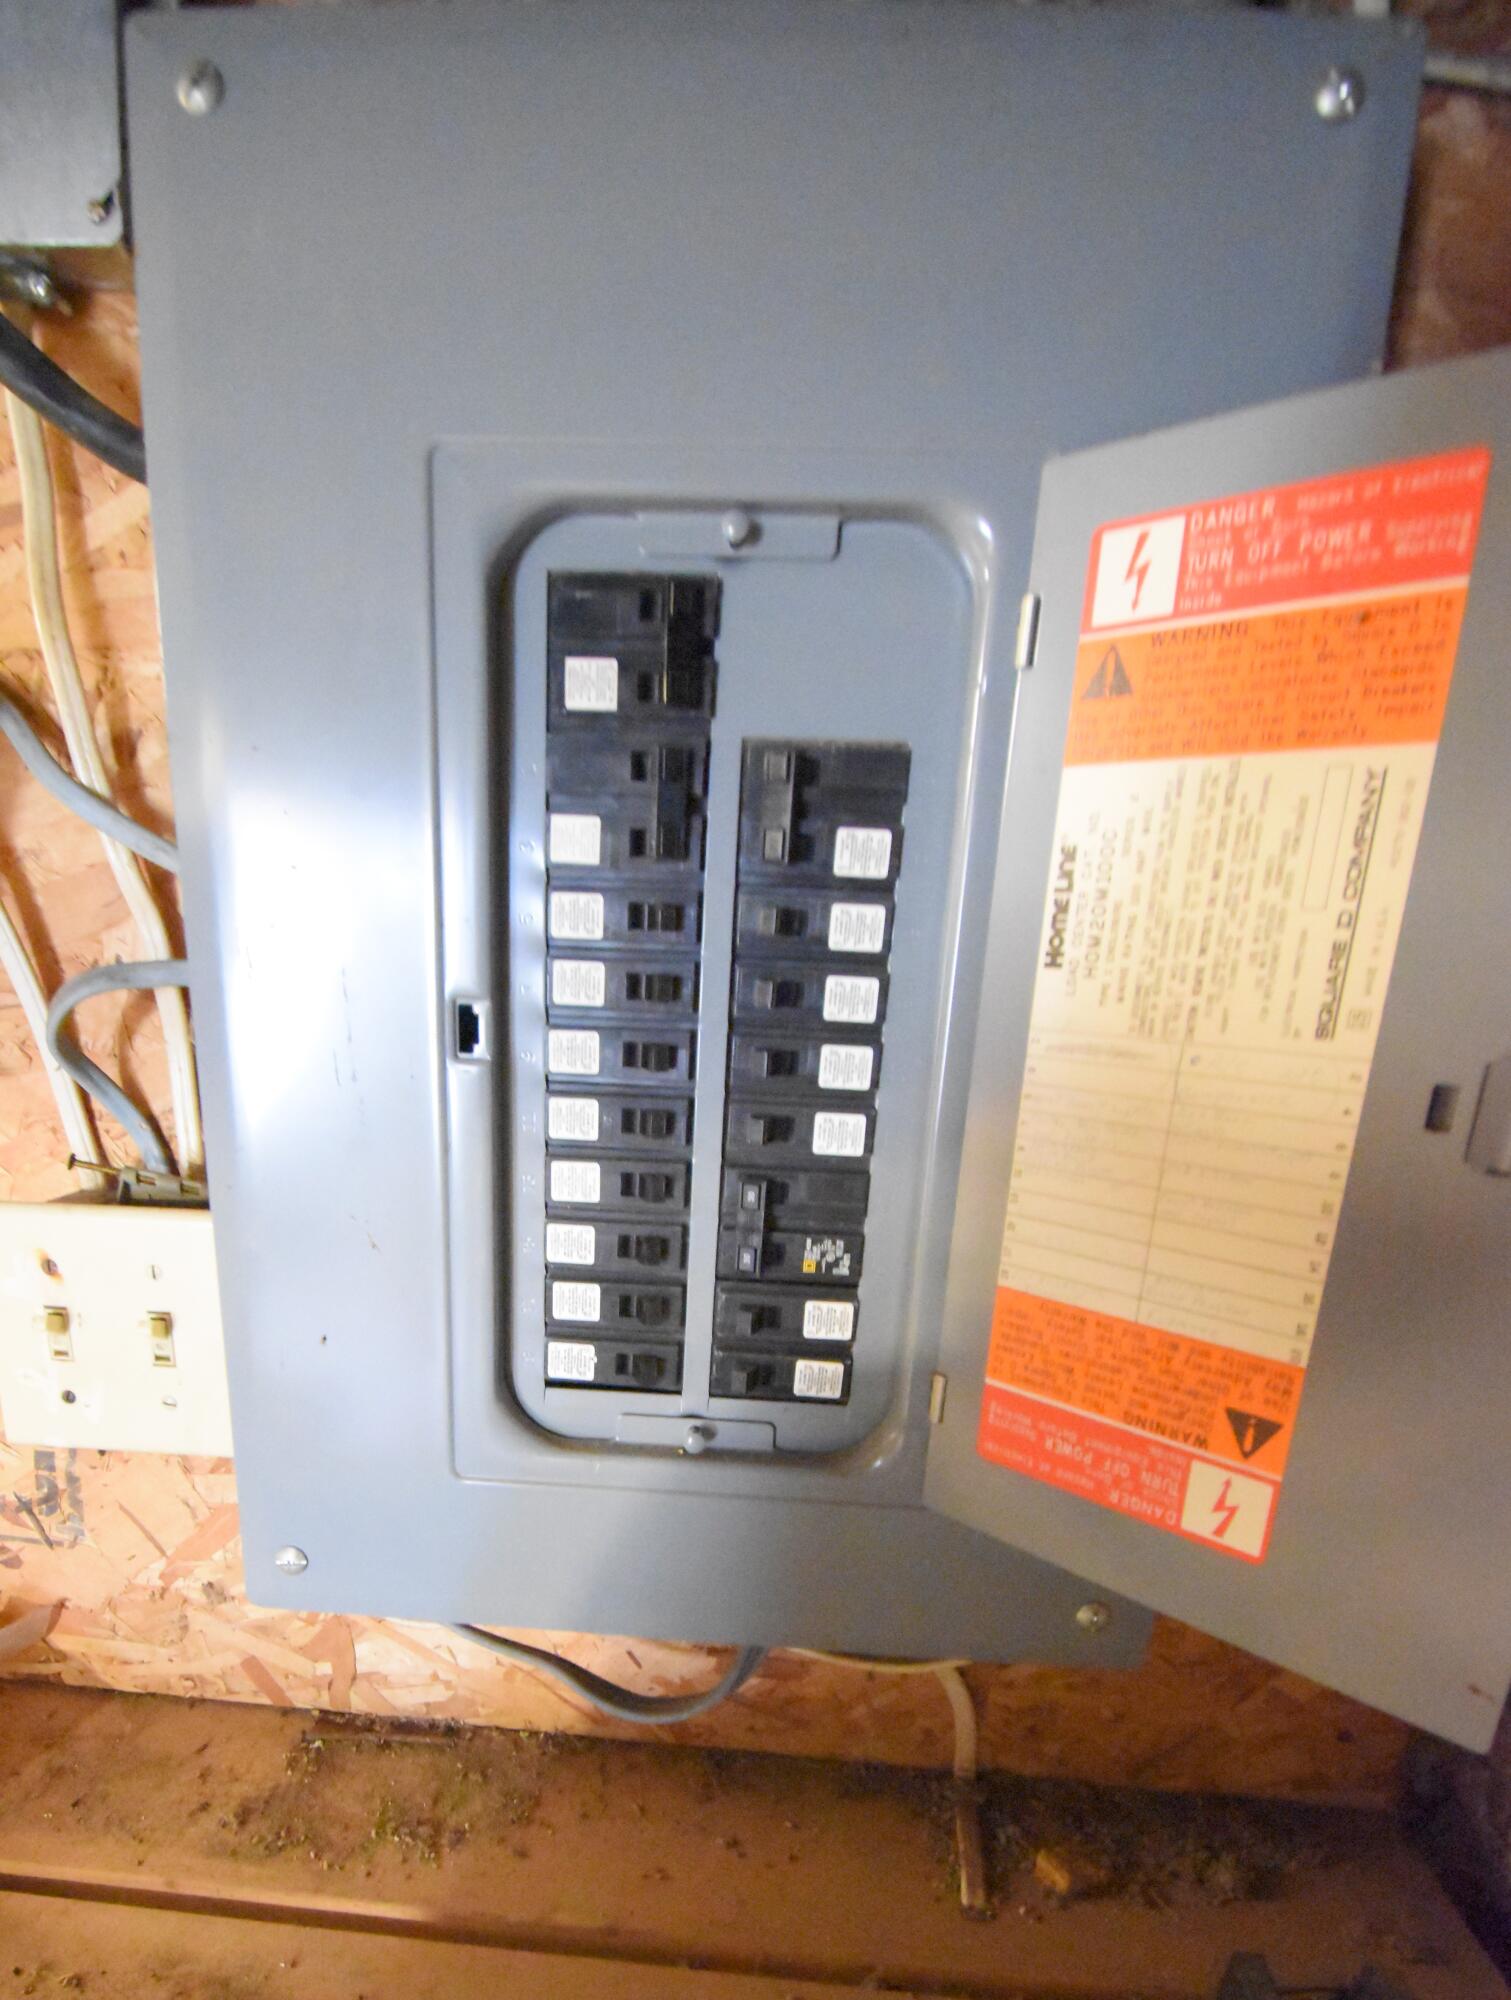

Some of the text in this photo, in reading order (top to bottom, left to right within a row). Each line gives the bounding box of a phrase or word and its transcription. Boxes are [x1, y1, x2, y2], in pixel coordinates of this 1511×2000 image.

[1188, 494, 1276, 534] DANGER
[1184, 543, 1235, 576] TURN
[1246, 535, 1281, 565] OFF
[1297, 518, 1374, 557] POWER
[1149, 618, 1250, 648] WARNING
[1339, 766, 1382, 902] COMPANY
[1334, 910, 1354, 928] D
[1311, 939, 1347, 1040] SQUARE
[1122, 1408, 1209, 1450] WARNING
[1043, 1433, 1094, 1466] POWER
[1107, 1486, 1177, 1526] DANGER
